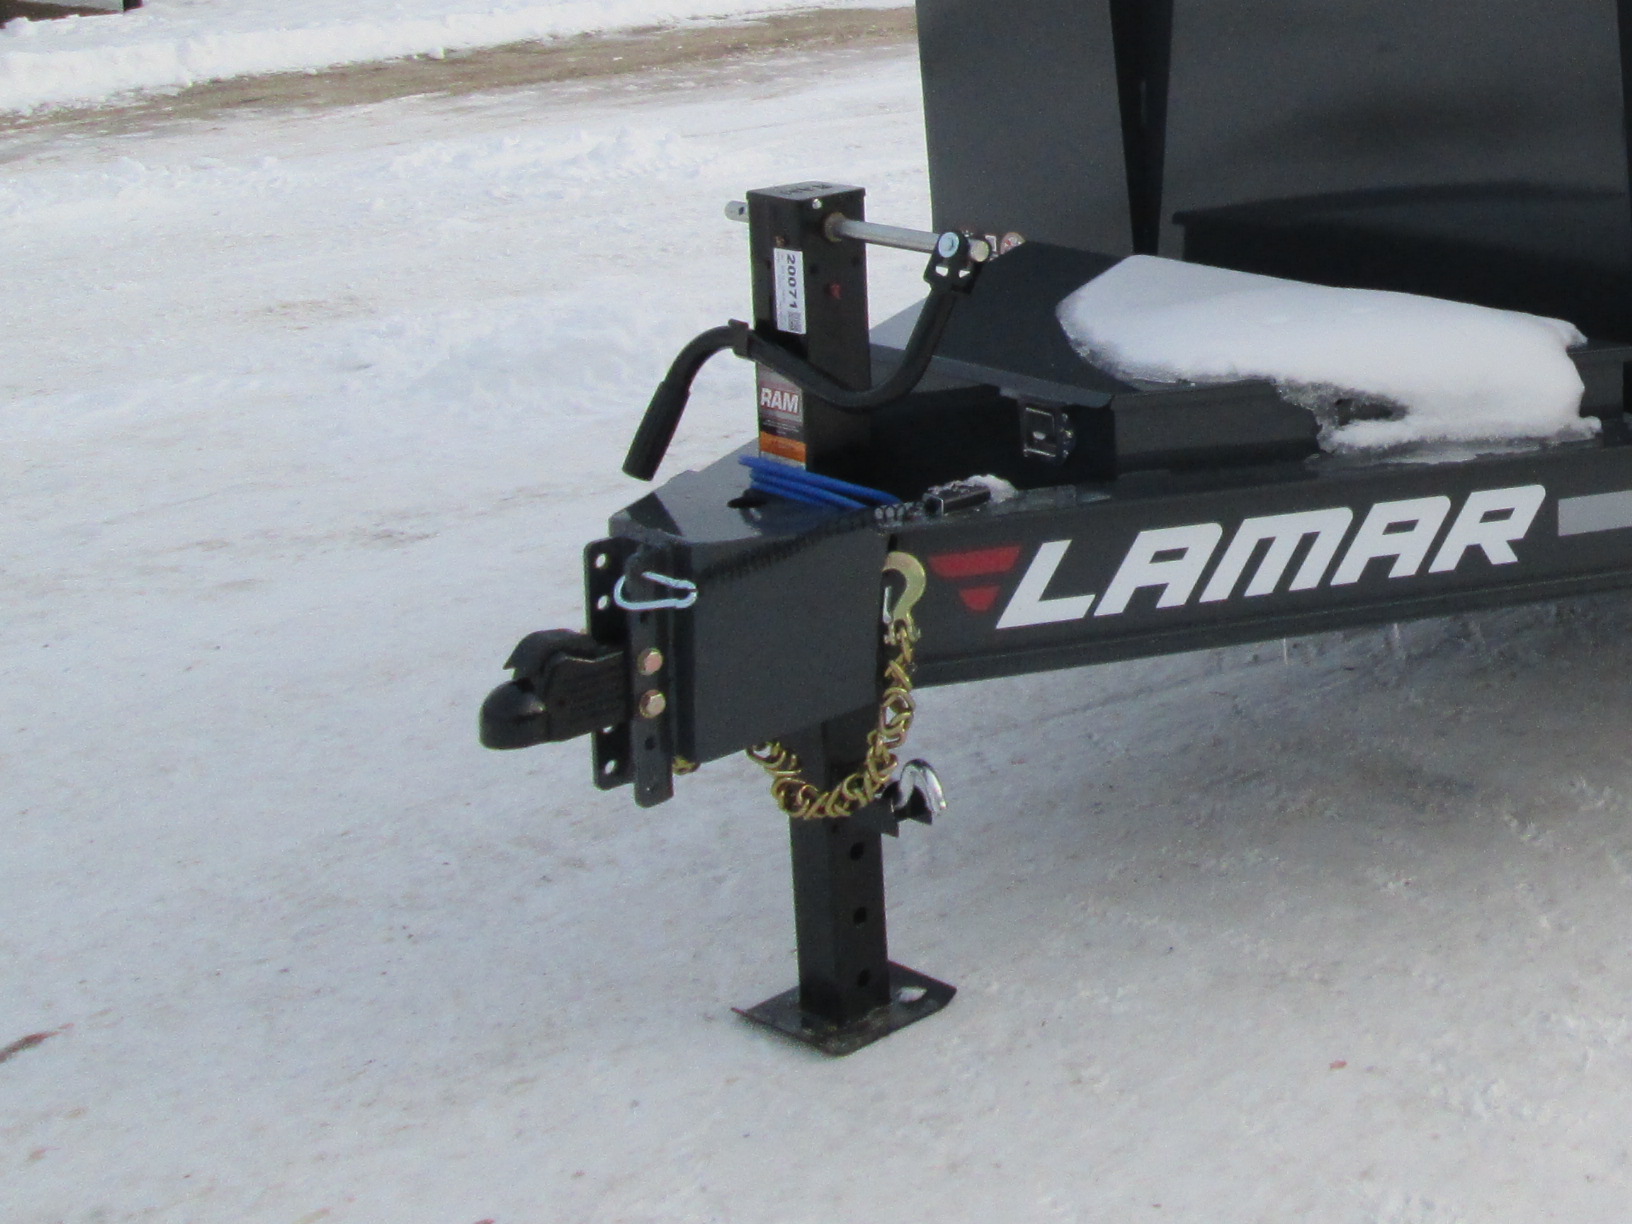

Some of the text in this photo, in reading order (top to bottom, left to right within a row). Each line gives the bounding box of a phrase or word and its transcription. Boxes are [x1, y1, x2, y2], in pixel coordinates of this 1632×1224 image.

[786, 254, 798, 309] 20071
[760, 387, 800, 414] RAM
[996, 484, 1547, 629] LAMAR
